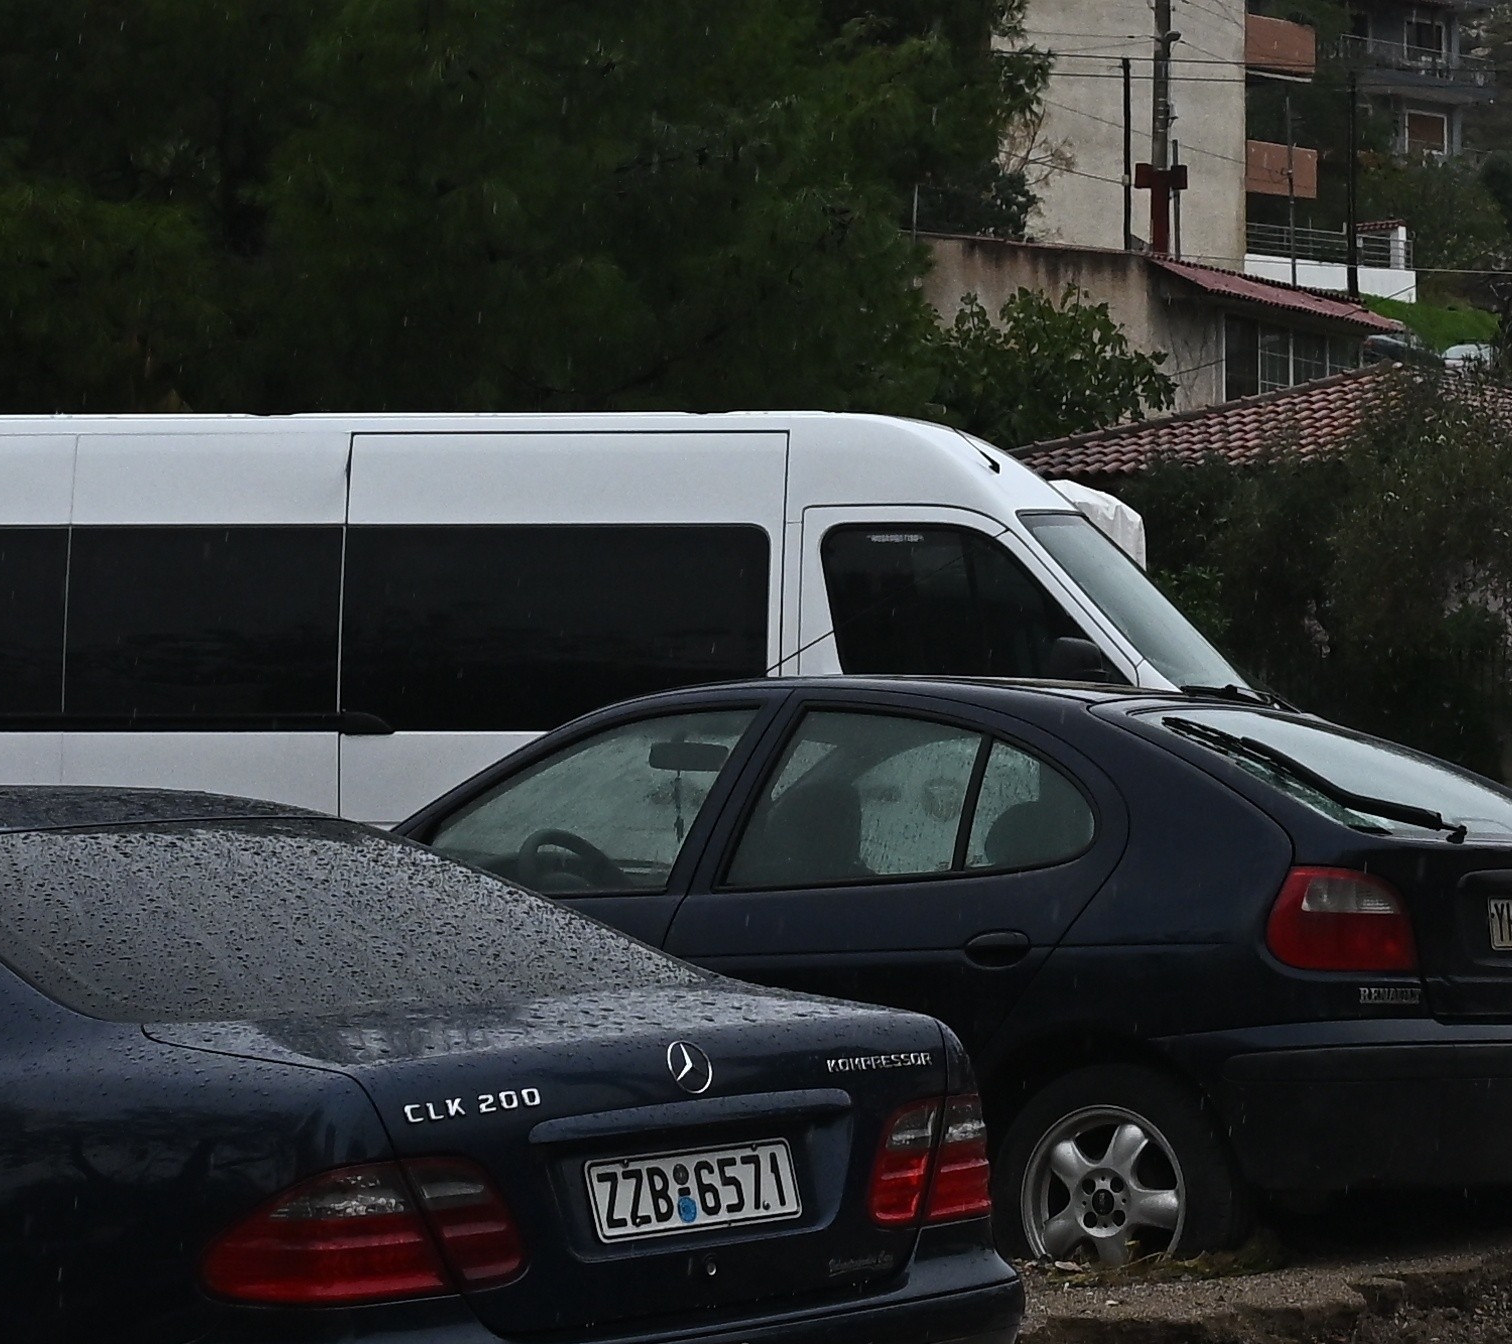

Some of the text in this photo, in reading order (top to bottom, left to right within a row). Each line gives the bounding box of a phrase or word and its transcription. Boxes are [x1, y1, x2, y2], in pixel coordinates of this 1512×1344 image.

[826, 1052, 933, 1073] KOMPRESSOR
[404, 1087, 542, 1123] CLK 200
